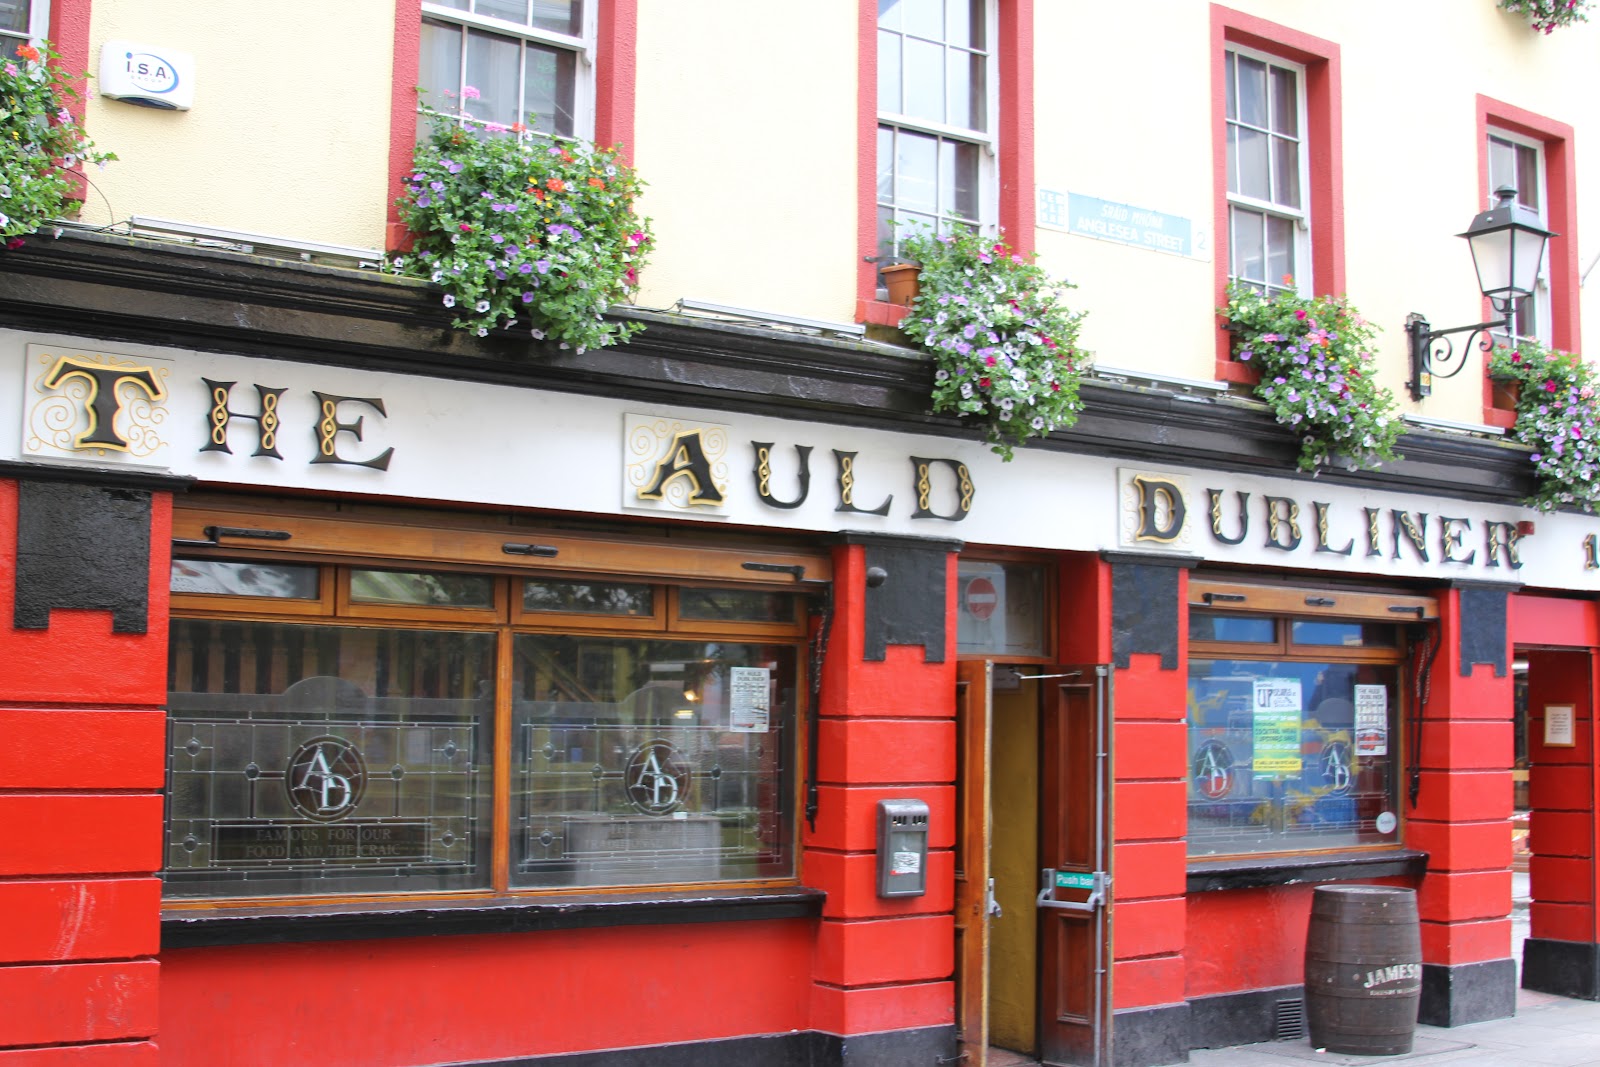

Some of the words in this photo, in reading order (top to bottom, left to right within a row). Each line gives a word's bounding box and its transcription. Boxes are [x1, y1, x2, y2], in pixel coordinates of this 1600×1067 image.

[1076, 216, 1140, 242] ANGLESEA
[1144, 230, 1185, 252] STREET
[1196, 231, 1207, 250] 2
[43, 355, 395, 473] THE
[636, 427, 976, 523] AULD
[1133, 473, 1524, 570] DUBLINER
[256, 829, 319, 841] FAMOUS
[328, 829, 356, 841] FOR
[362, 828, 392, 840] OUR
[245, 845, 286, 857] FOOD
[294, 845, 324, 856] AND
[328, 844, 355, 856] THE
[1057, 874, 1079, 885] Push
